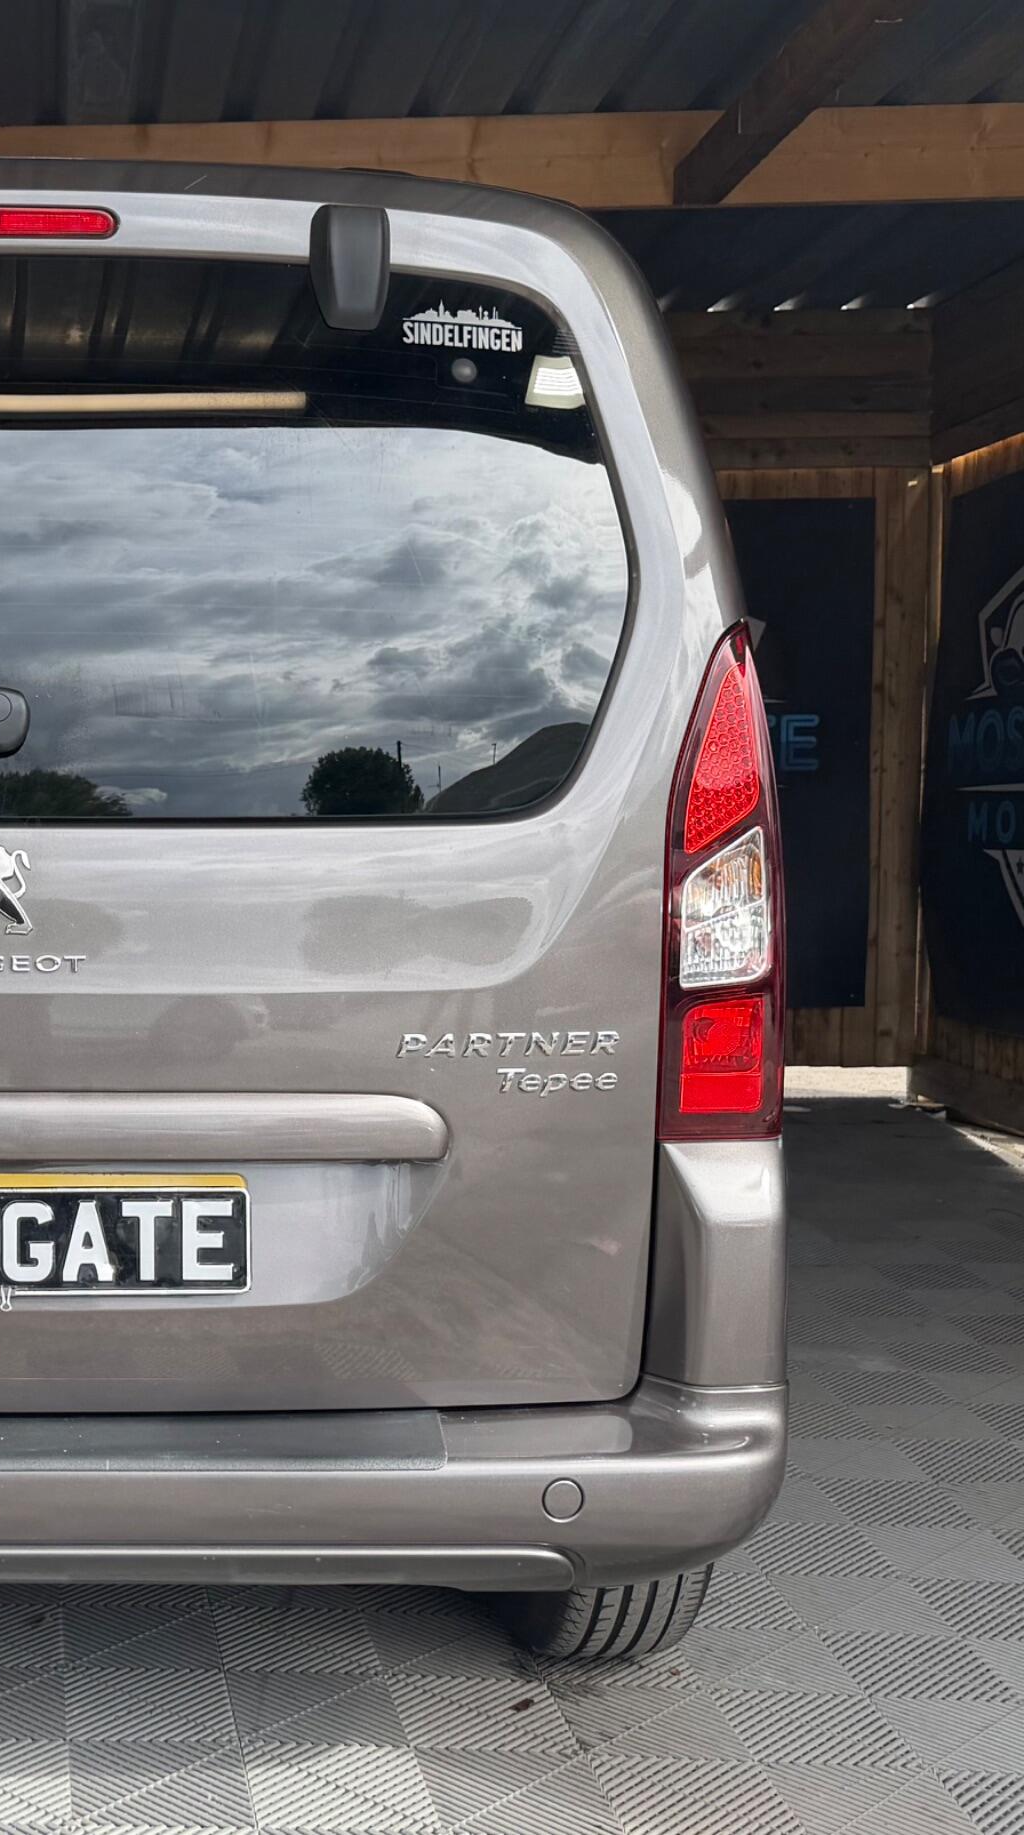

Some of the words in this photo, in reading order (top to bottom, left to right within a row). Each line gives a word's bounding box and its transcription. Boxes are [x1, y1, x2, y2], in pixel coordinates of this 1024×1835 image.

[403, 321, 522, 352] SINDELFINGEN
[397, 1031, 621, 1058] PARTNER
[496, 1067, 618, 1097] Tepee
